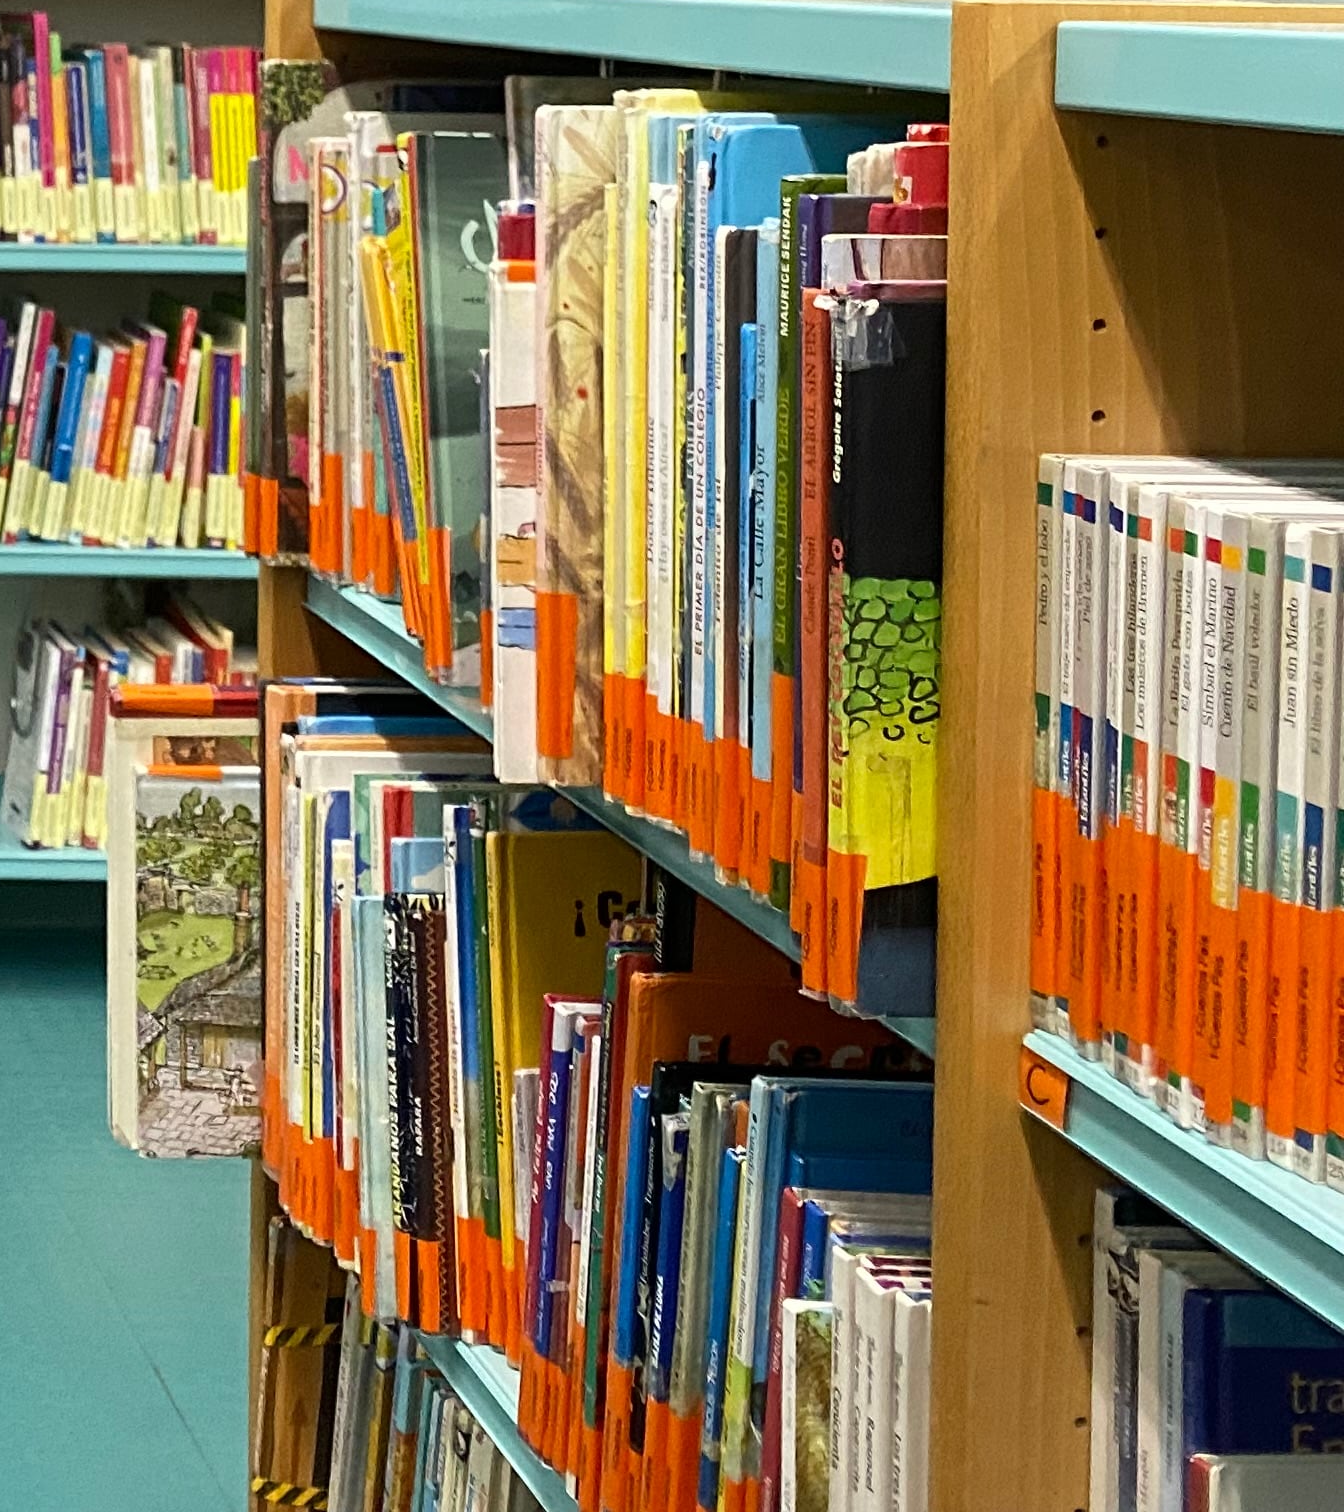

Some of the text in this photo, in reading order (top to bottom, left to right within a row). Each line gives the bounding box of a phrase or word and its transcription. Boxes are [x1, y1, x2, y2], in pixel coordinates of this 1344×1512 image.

[779, 197, 792, 337] MAURICE SENDAK
[756, 325, 766, 368] Melvin
[805, 322, 816, 358] FIN
[805, 363, 816, 395] SIN
[832, 412, 844, 482] Grégoire
[659, 482, 670, 497] en
[692, 389, 707, 654] EL PRIMER DÍA DE UN COLEGIO
[754, 445, 770, 599] La Calle Mayor
[775, 389, 790, 643] EL GRAN LIBRO VERDE
[805, 485, 816, 499] EL
[805, 537, 816, 634] Claude Ponti
[1038, 520, 1053, 625] Pedro y el lobo
[1081, 575, 1092, 586] de
[1081, 596, 1092, 623] Piel
[1134, 556, 1148, 729] Los músicos de Bremen
[1181, 571, 1194, 711] El gato con botas
[1126, 670, 1137, 693] Las
[1201, 578, 1218, 728] Simbad el Marino
[1219, 586, 1236, 738] Cuento de Navidad
[1247, 589, 1260, 711] El baúl volador
[1282, 598, 1299, 728] Juan sin Miedo
[1310, 608, 1325, 755] El libro de la selva
[831, 777, 844, 808] EL
[314, 1026, 322, 1049] lobo
[385, 1016, 397, 1051] SAL
[387, 1055, 399, 1108] PARA
[549, 1072, 559, 1103] DOS
[1025, 1062, 1050, 1106] C
[414, 1097, 424, 1155] RAFARA
[736, 1125, 758, 1355] Cuando los cuervos eran multicolores
[831, 1386, 843, 1470] Cenicienta
[852, 1405, 861, 1493] Caperucita
[865, 1417, 876, 1493] Rapunzel
[893, 1433, 903, 1494] Los tres
